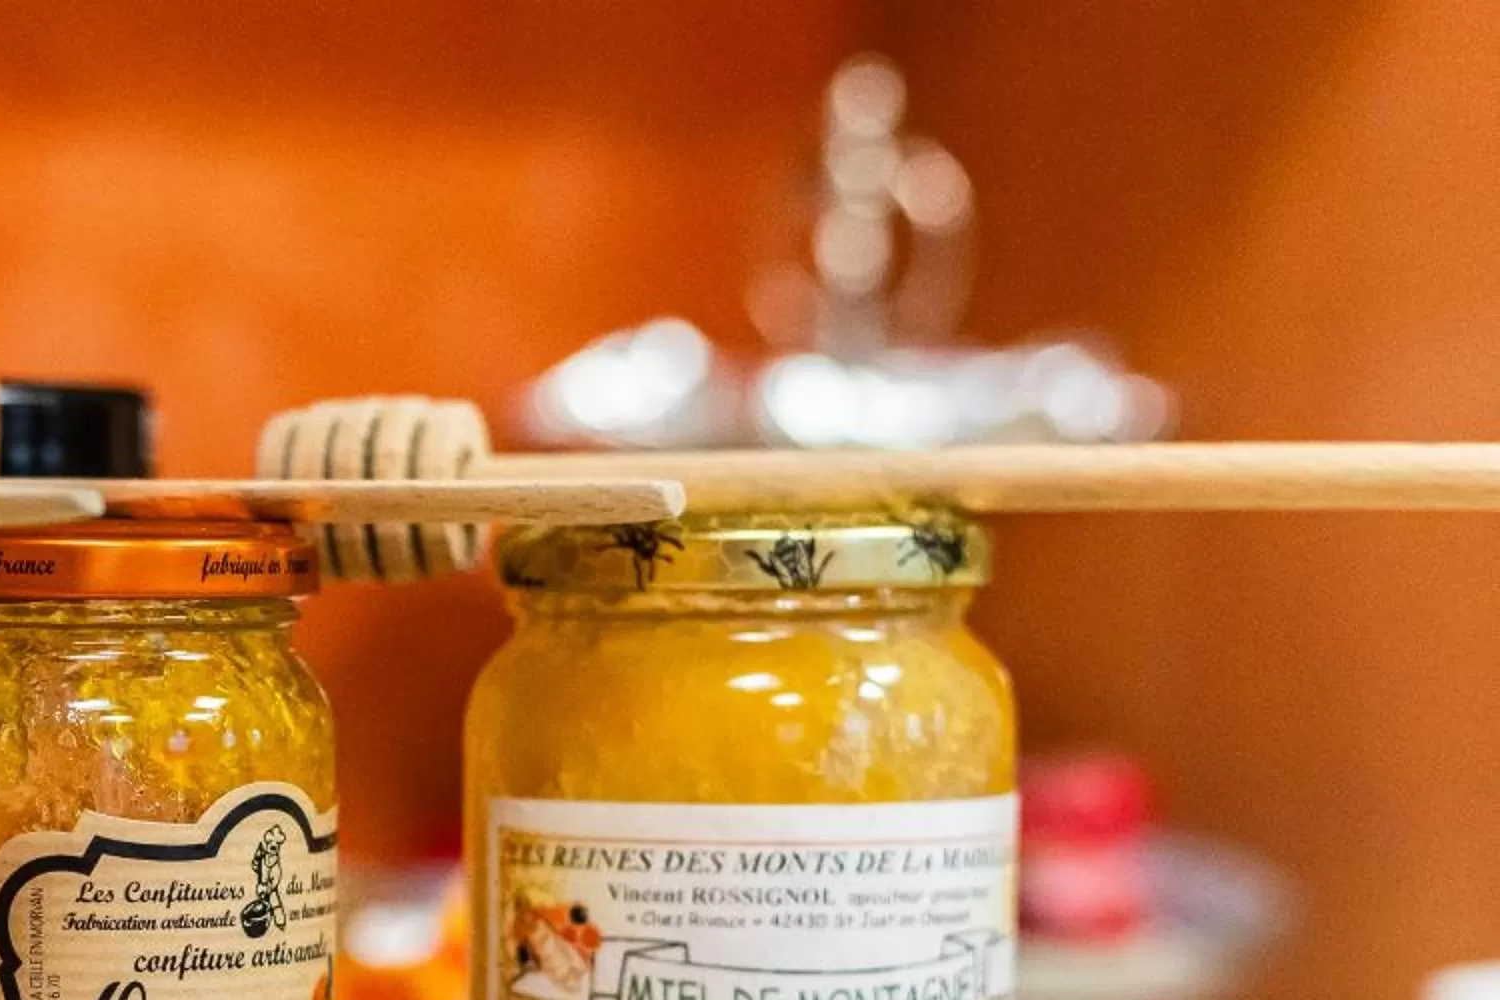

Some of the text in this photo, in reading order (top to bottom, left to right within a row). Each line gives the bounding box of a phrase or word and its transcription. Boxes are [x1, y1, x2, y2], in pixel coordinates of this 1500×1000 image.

[550, 844, 656, 873] REINES
[662, 849, 726, 875] DES
[730, 850, 848, 876] MONTS
[855, 849, 898, 875] DE
[76, 881, 115, 905] Les
[124, 882, 245, 909] Confituriers
[286, 874, 303, 895] du
[607, 882, 684, 905] Vincent
[691, 885, 836, 907] ROSSIGNOL
[62, 911, 158, 932] Fabrication
[160, 909, 236, 930] artisanale
[134, 944, 245, 980] confiture
